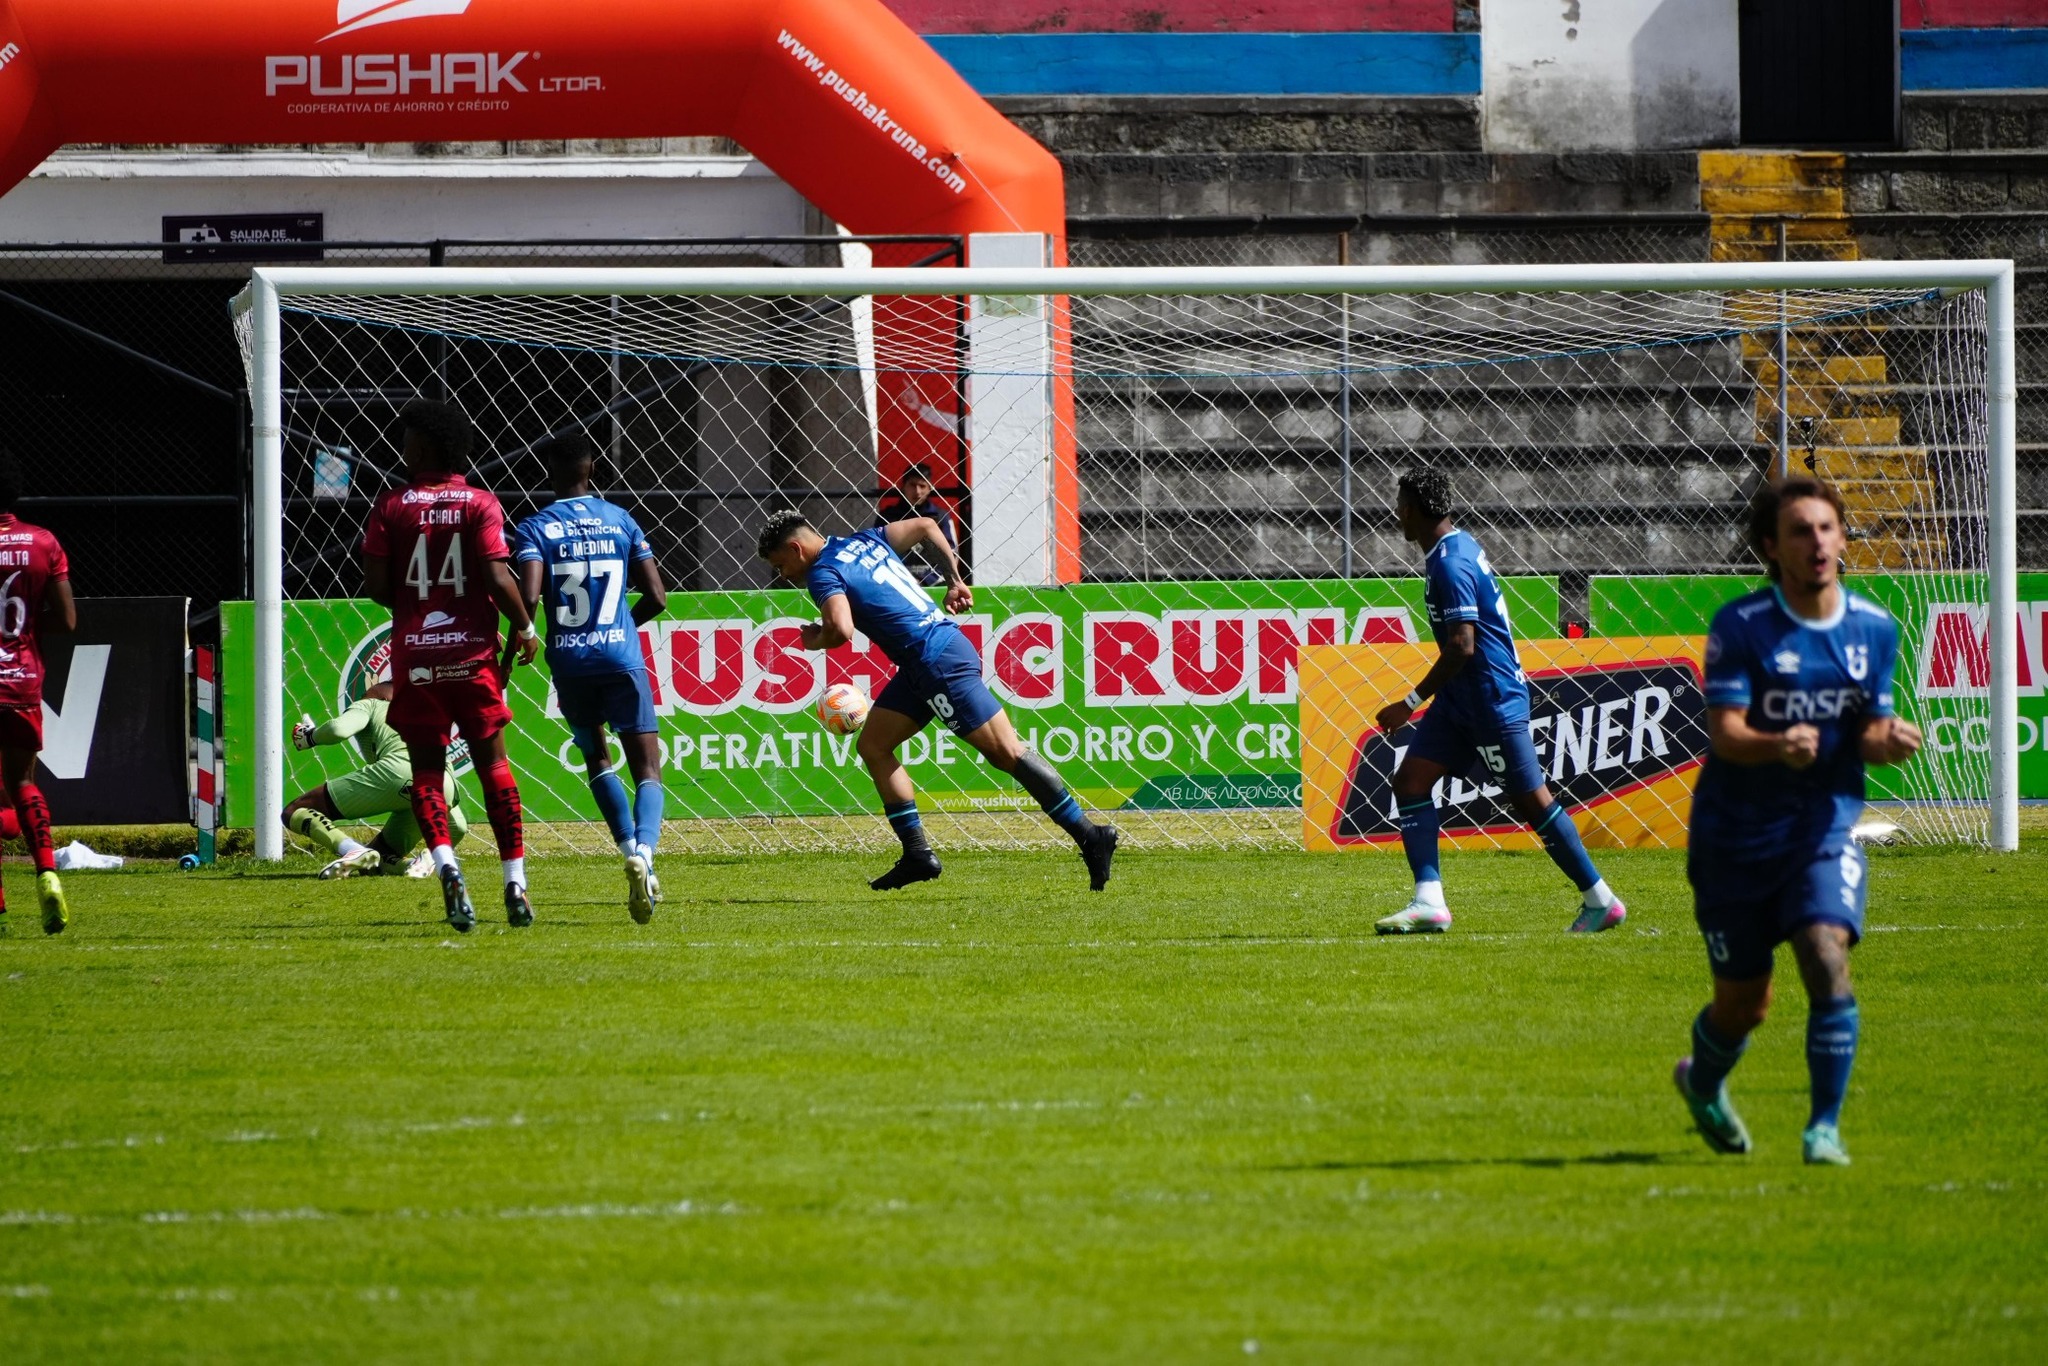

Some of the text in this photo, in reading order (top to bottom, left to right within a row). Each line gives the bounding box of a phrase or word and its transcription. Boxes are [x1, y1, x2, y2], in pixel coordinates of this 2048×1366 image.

[265, 51, 530, 97] PUSHAK
[287, 98, 510, 114] COOPERATIVA DE AHORRO Y CRÉDITO
[777, 29, 966, 194] www.pushakruna.com
[230, 229, 287, 240] SALIDA DE
[428, 509, 461, 525] CHALA
[10, 534, 33, 542] WASI
[559, 540, 616, 558] C. MEDINA
[0, 551, 29, 566] ALTA
[405, 532, 467, 600] 44
[551, 559, 624, 628] 37
[405, 631, 468, 646] PUSHAK
[555, 628, 625, 649] DISCOVER
[545, 612, 1064, 718] USHC
[927, 693, 954, 722] 18
[559, 723, 1302, 773] COPERATIV DE ORRO Y CR
[1930, 716, 2048, 753] COO
[1388, 685, 1671, 822] LENER
[1475, 744, 1506, 773] 15
[1185, 786, 1217, 800] LUIS
[1218, 785, 1290, 800] ALFONSO
